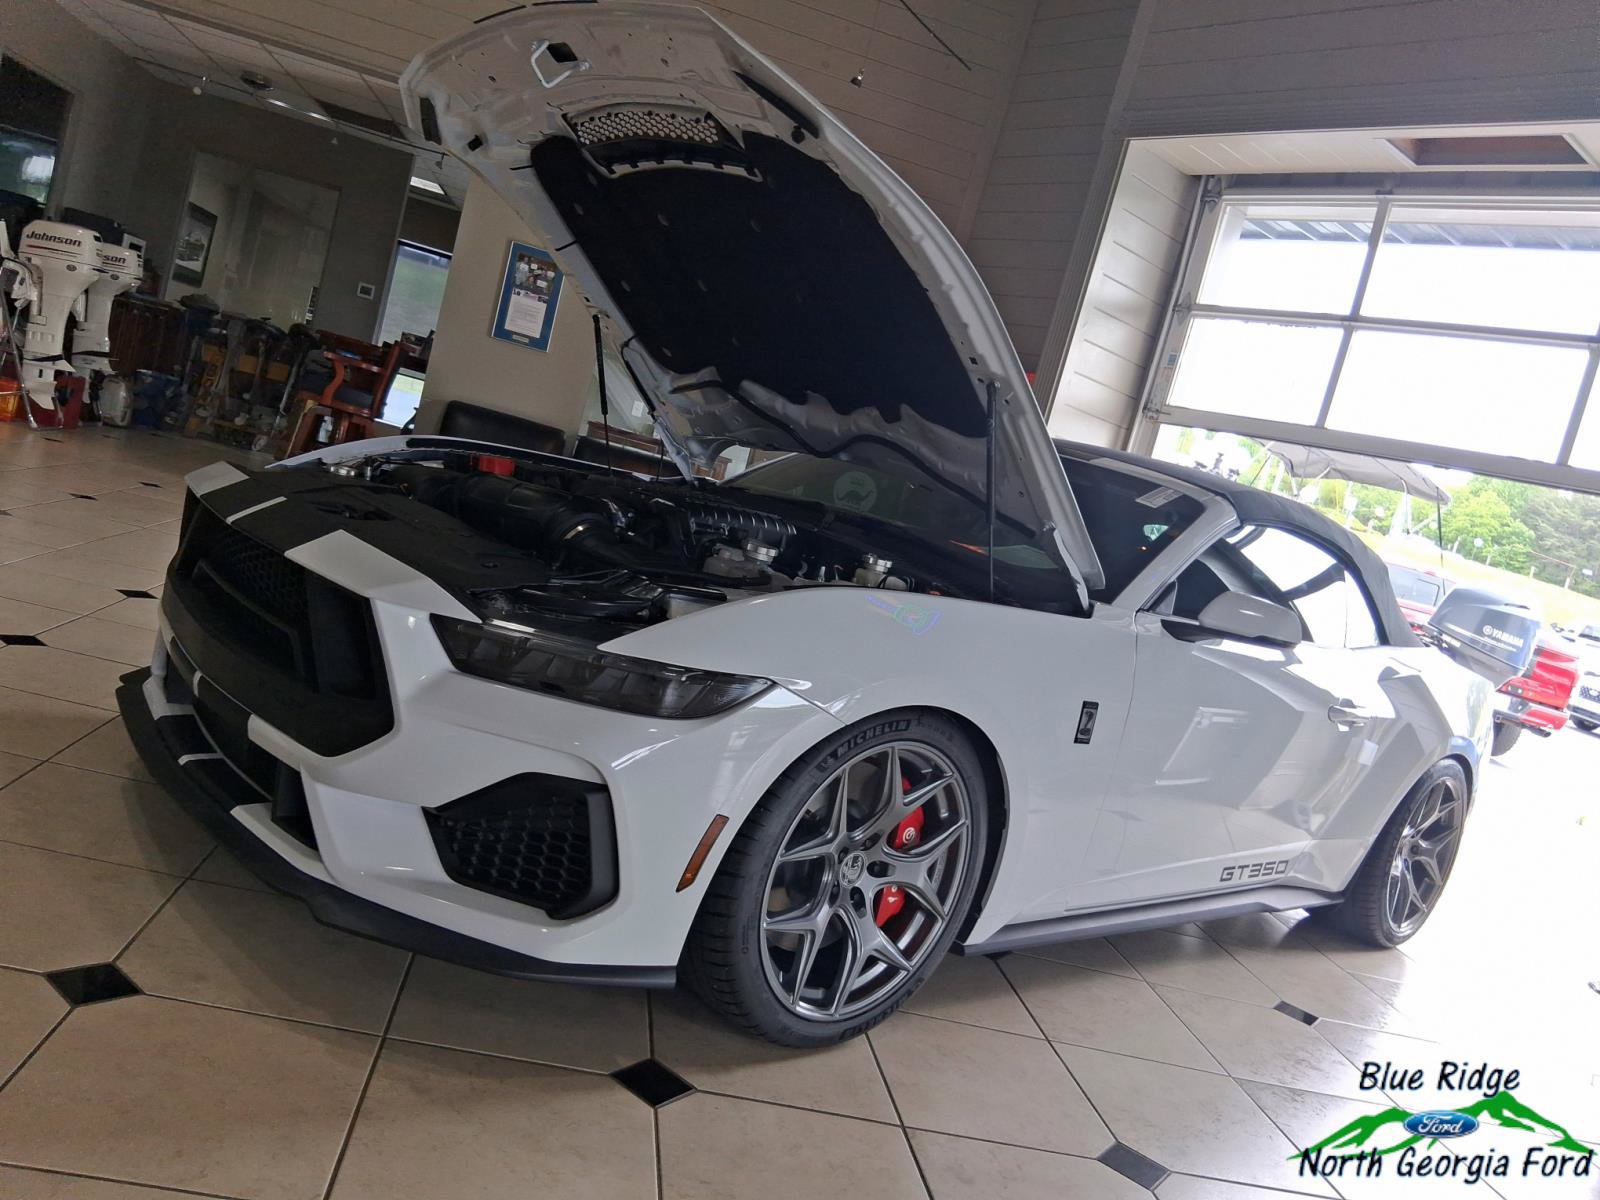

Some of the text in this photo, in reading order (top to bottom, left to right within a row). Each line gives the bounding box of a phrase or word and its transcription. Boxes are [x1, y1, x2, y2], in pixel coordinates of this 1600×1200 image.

[26, 231, 82, 247] Johnson
[837, 719, 908, 757] MICHELIN
[1219, 860, 1289, 882] GT350
